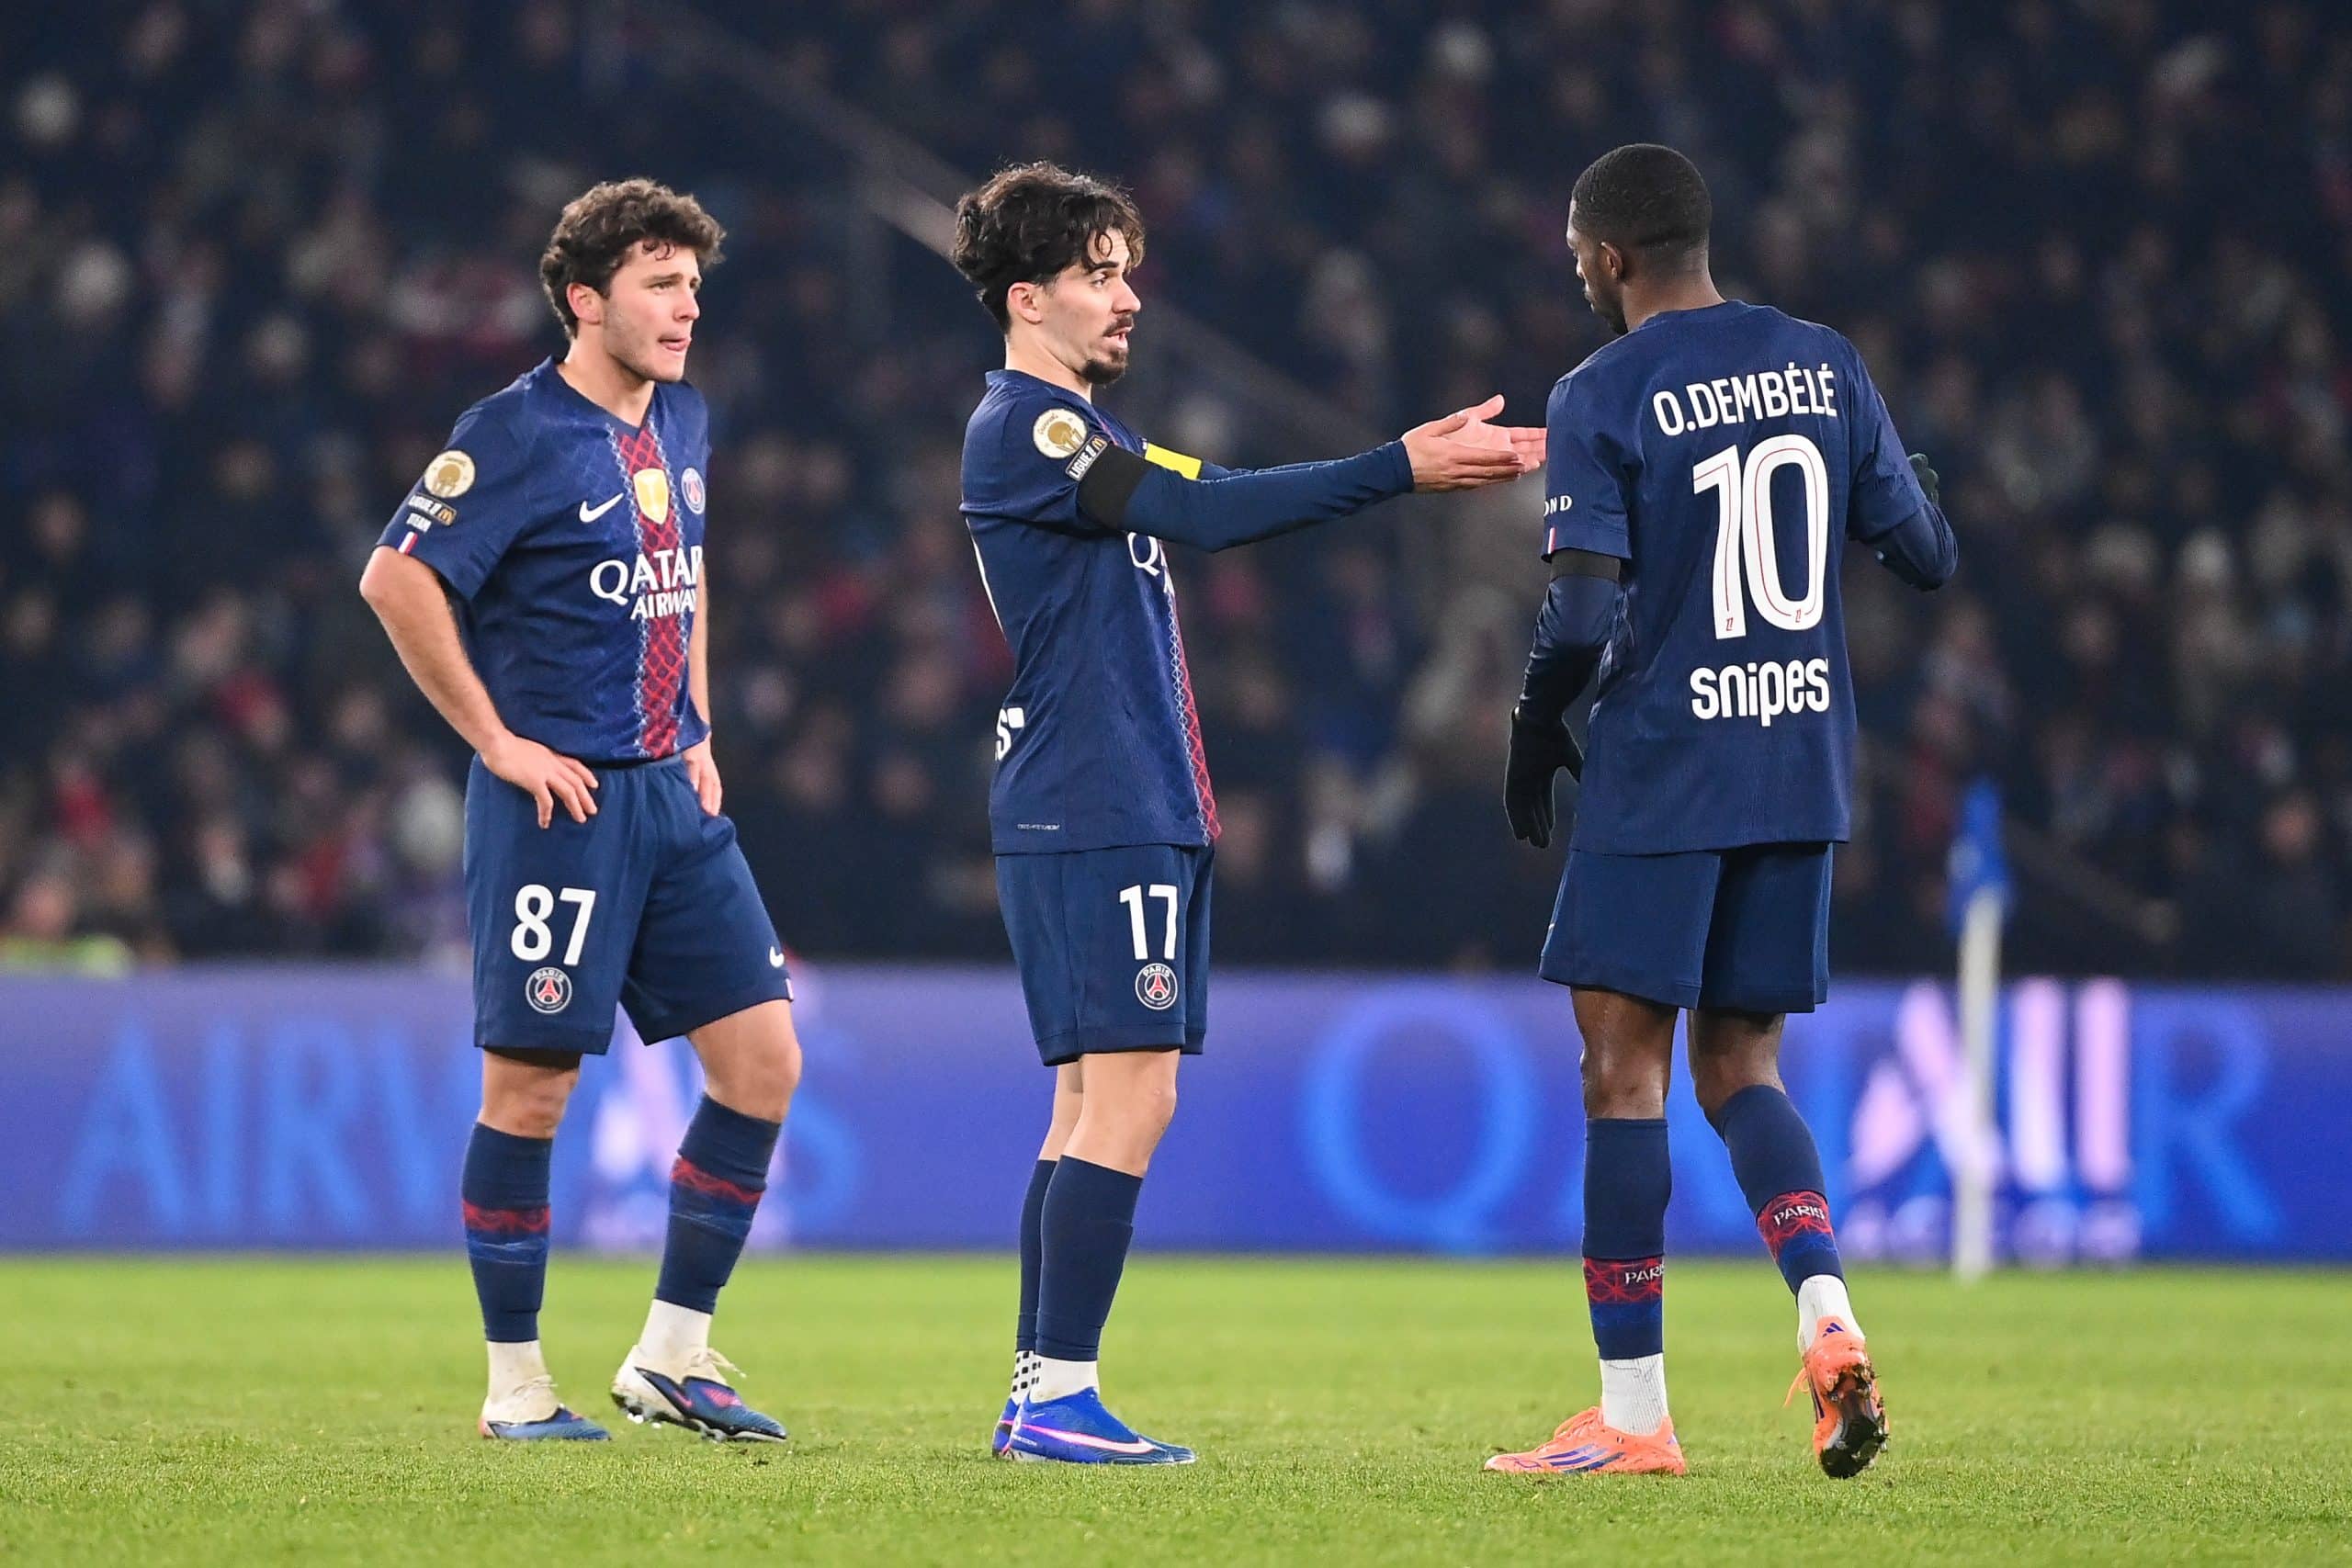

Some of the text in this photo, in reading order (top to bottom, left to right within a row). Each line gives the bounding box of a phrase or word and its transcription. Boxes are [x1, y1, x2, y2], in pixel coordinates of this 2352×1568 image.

[1653, 362, 1837, 436] O.DEMBÉLÉ
[1692, 434, 1828, 639] 10
[630, 589, 695, 620] AIRWA
[511, 884, 596, 966] 87
[1120, 885, 1178, 960] 17
[1774, 1205, 1826, 1226] PARIS
